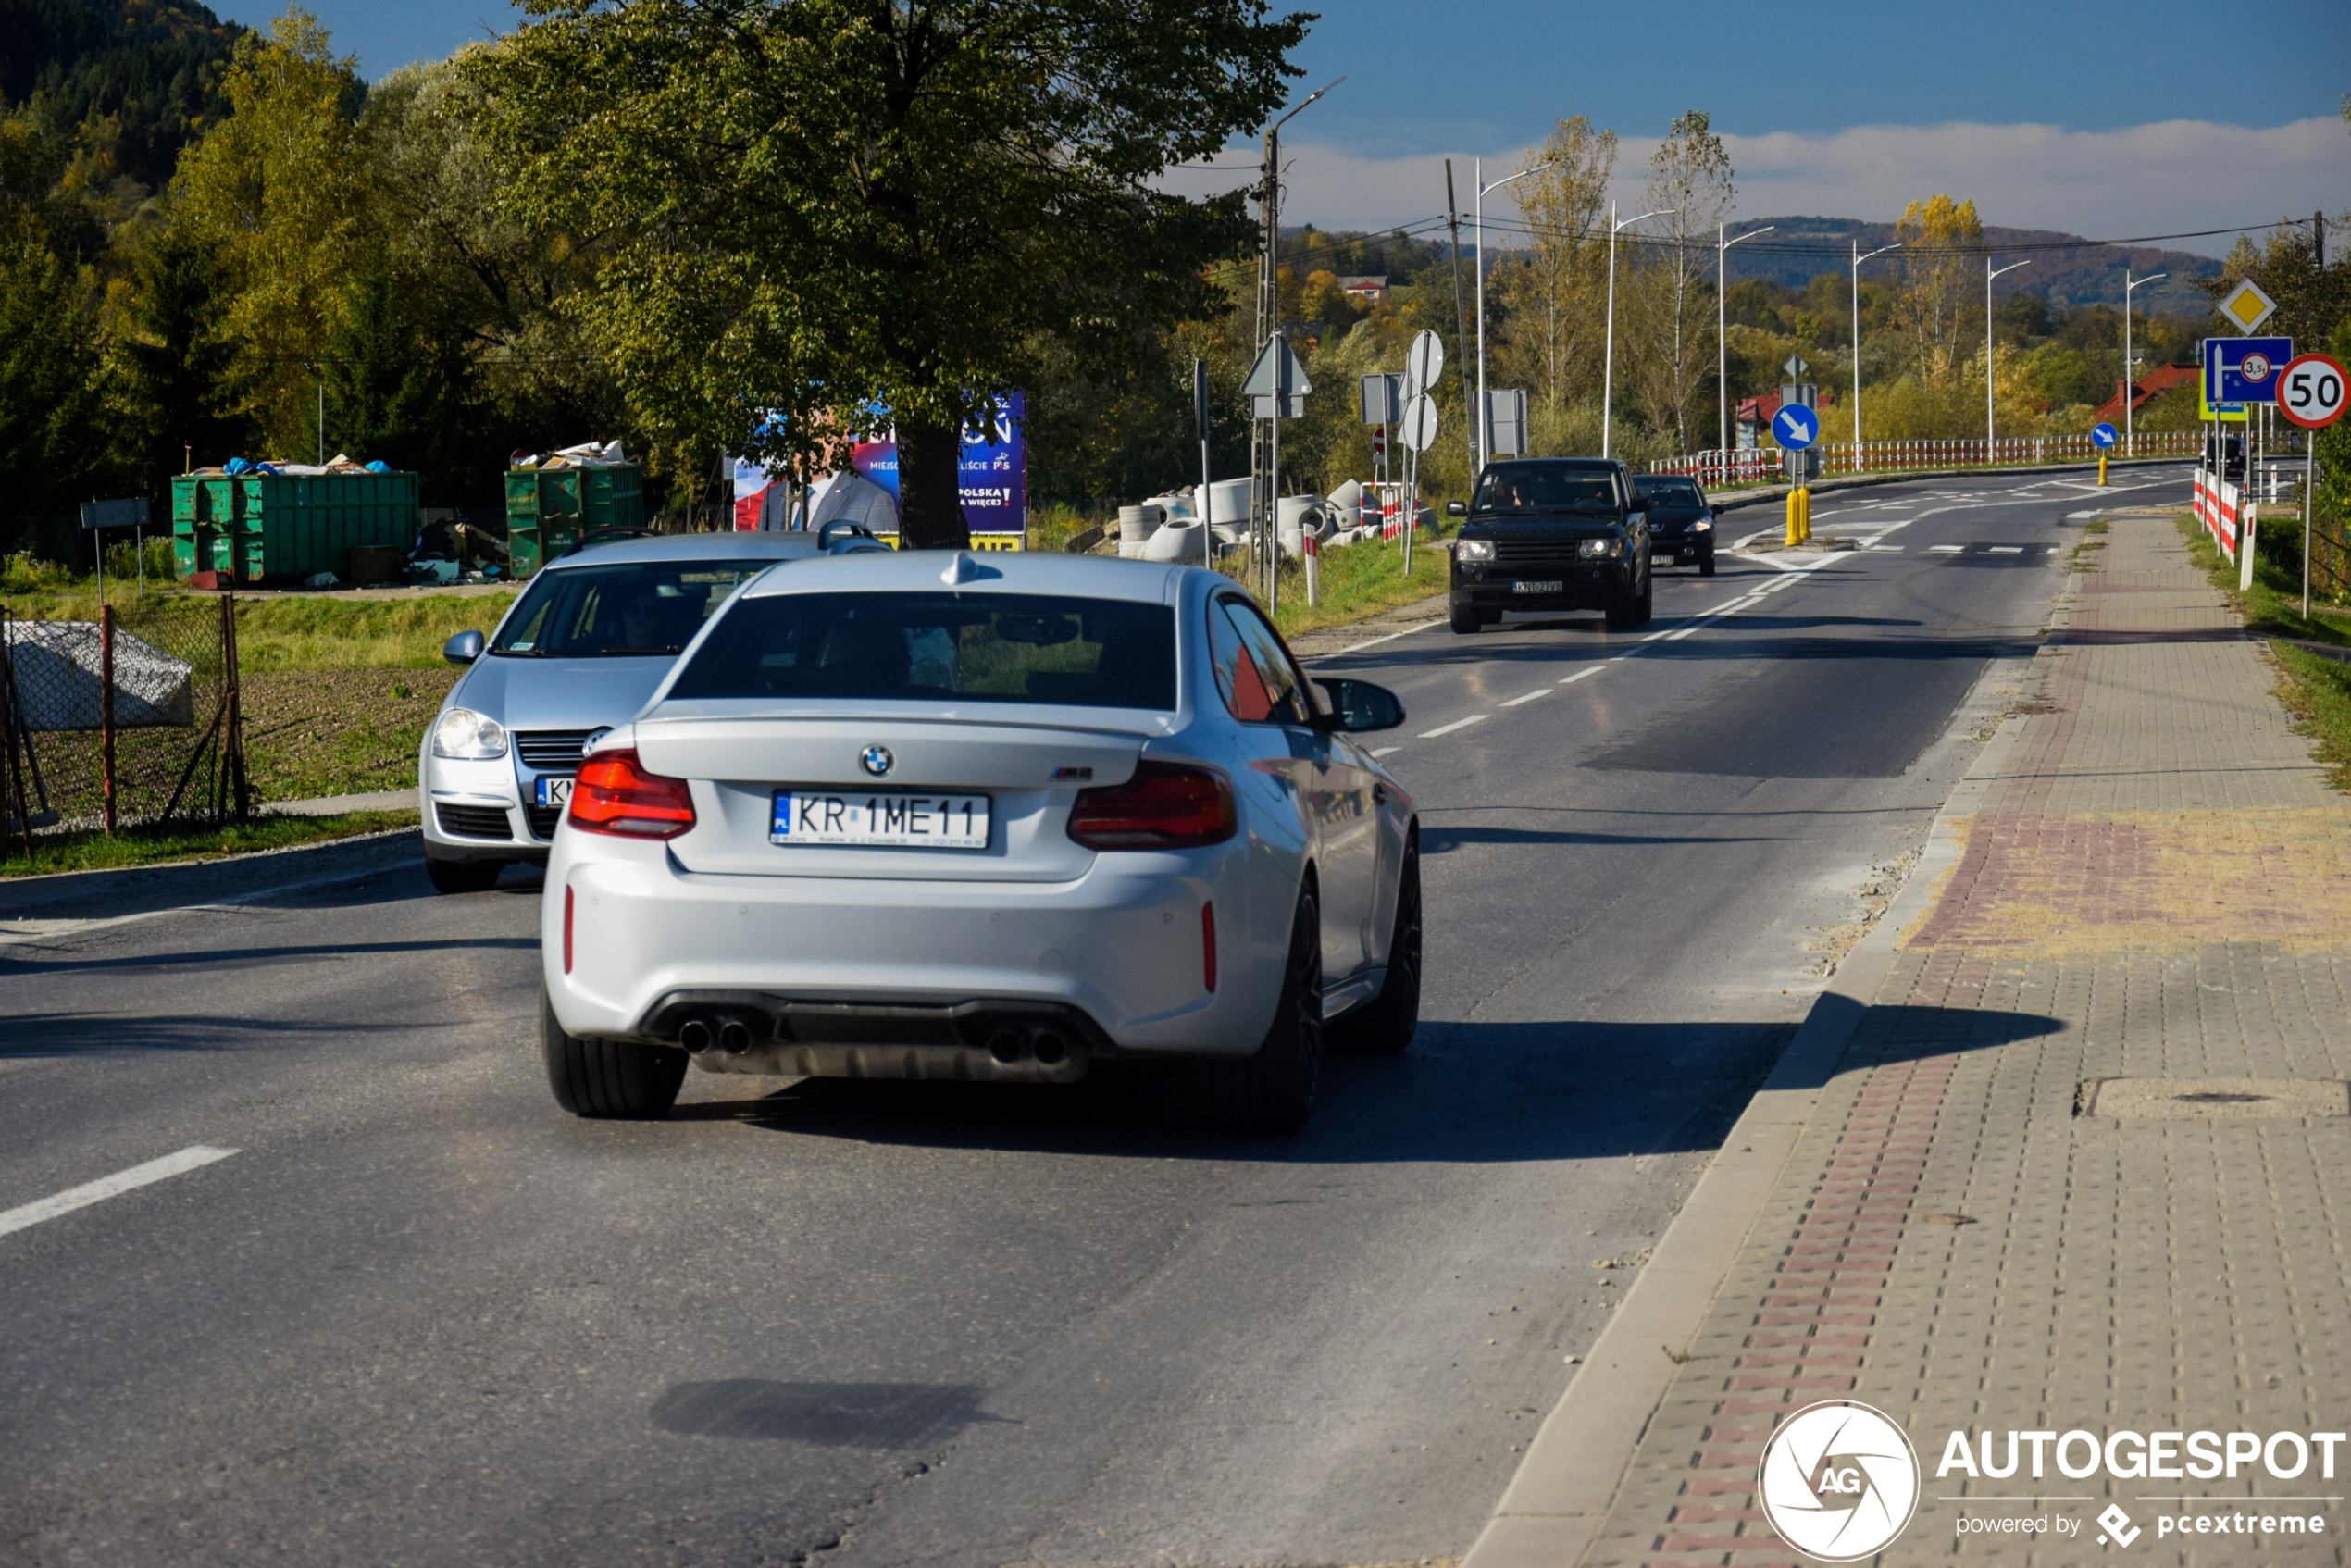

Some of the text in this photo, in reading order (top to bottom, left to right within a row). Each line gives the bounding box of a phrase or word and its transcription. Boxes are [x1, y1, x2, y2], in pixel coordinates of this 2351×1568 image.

[2290, 373, 2341, 408] 50
[968, 498, 1001, 508] WIĘCEJ
[775, 796, 972, 835] PL KR 1ME11
